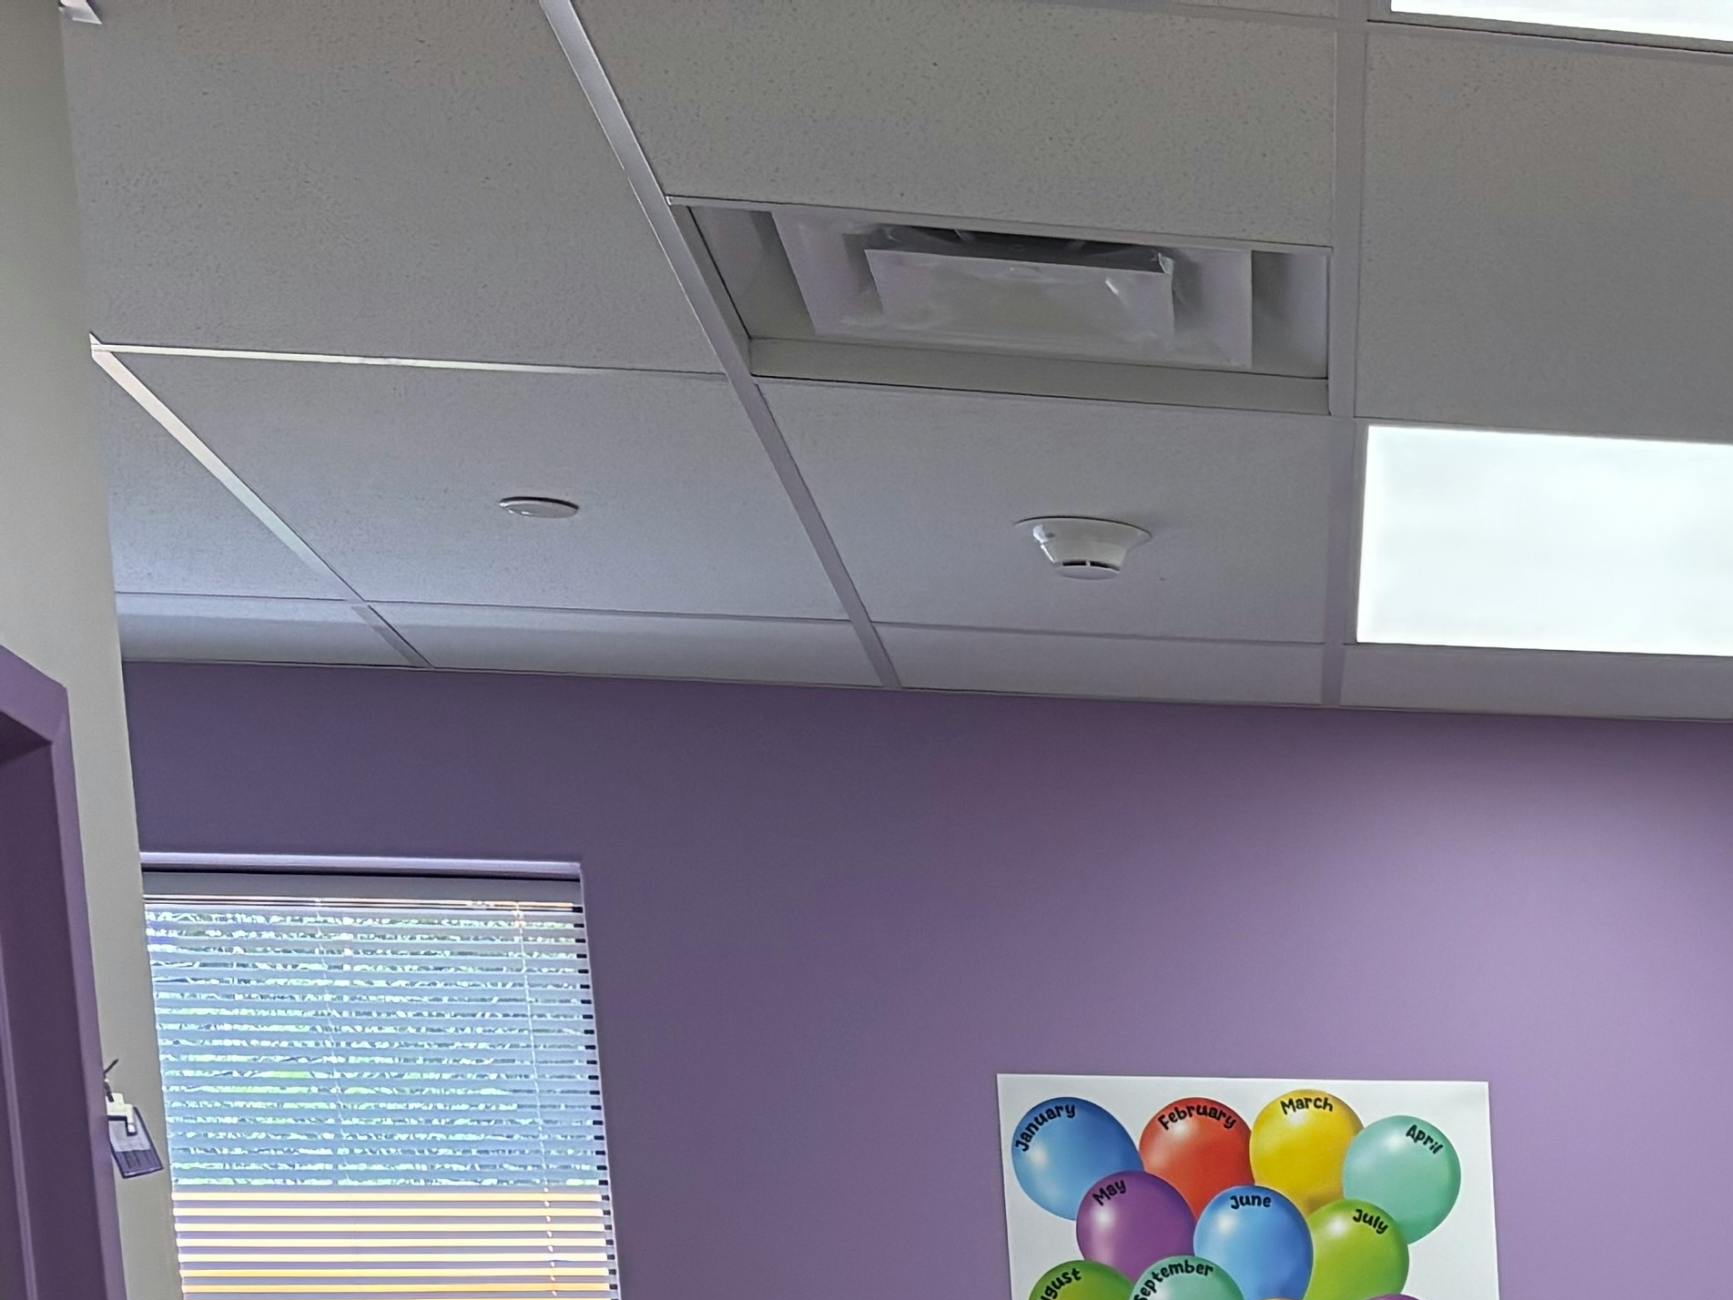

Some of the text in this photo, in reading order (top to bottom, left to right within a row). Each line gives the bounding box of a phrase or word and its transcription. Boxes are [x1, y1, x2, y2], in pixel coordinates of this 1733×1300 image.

[1157, 1104, 1237, 1130] February
[1280, 1096, 1334, 1115] March
[1016, 1102, 1077, 1153] January
[1405, 1123, 1445, 1156] April
[1091, 1178, 1127, 1206] May
[1229, 1193, 1272, 1211] June
[1352, 1207, 1389, 1236] July
